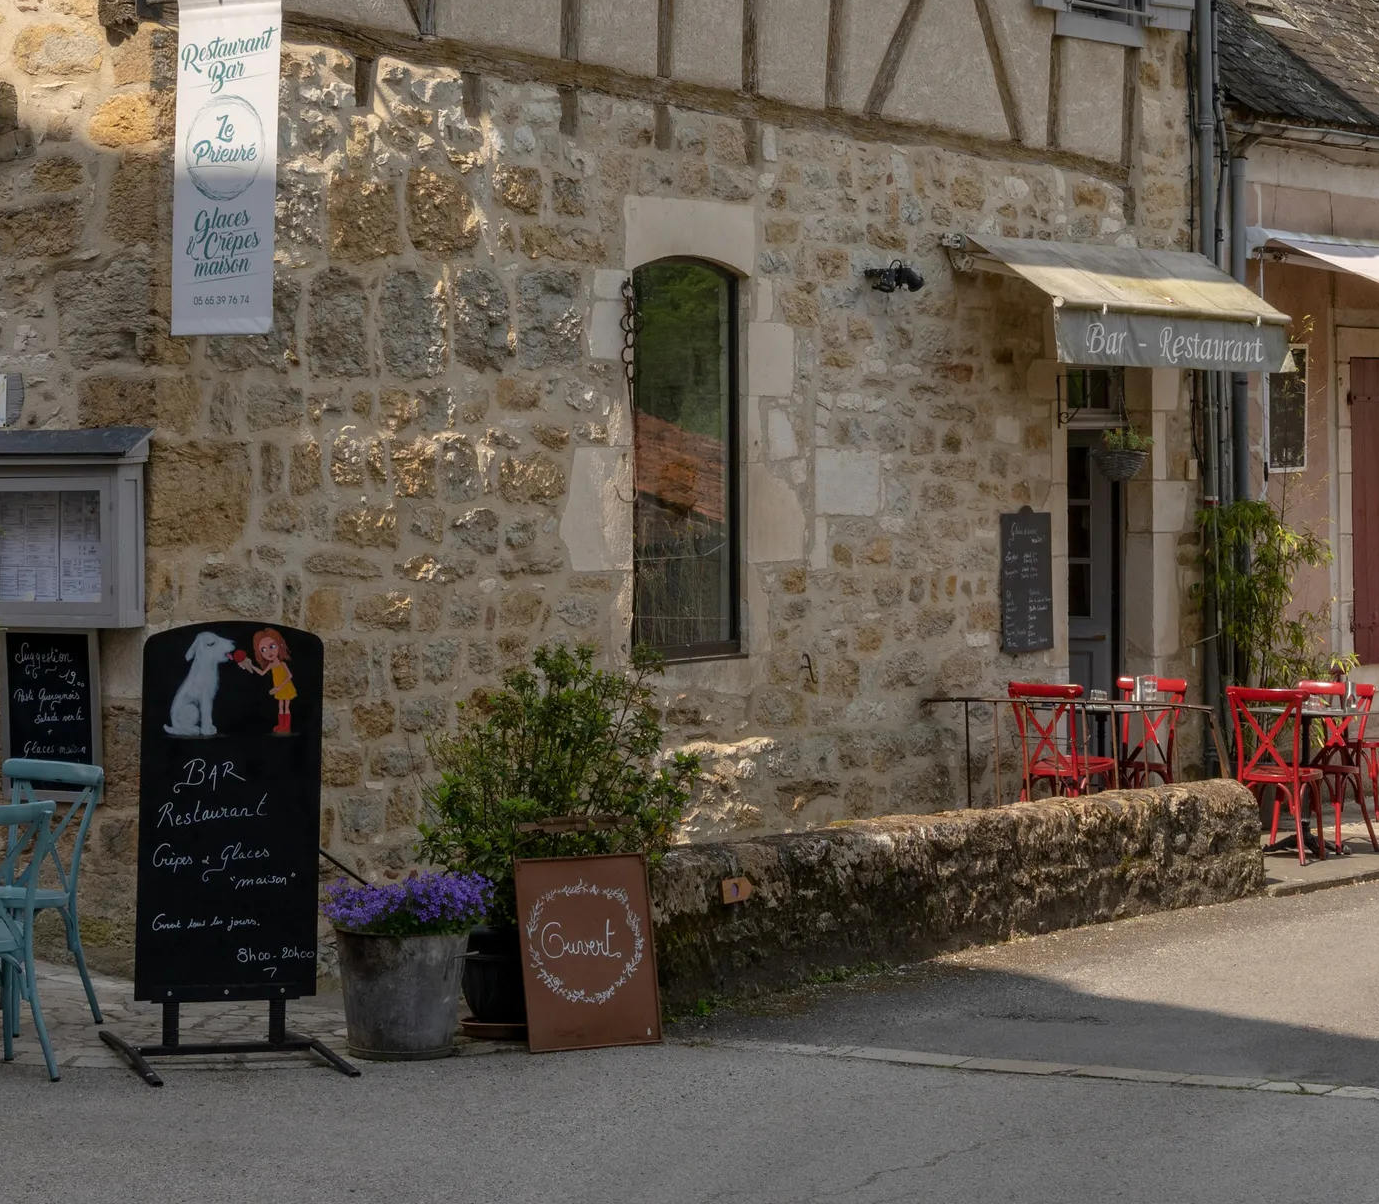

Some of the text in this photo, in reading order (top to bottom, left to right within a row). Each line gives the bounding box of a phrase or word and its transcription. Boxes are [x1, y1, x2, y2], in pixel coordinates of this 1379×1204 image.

[182, 26, 278, 74] Restaurant
[208, 60, 245, 94] Bar
[215, 114, 235, 143] Le
[192, 139, 257, 165] Prieuré
[194, 207, 250, 244] Glaces
[186, 231, 261, 261] & Crêpes
[194, 255, 251, 277] maison
[193, 295, 249, 305] 05 65 39 76 74
[1086, 322, 1127, 355] Bar
[1159, 326, 1265, 364] Restaurant
[15, 642, 73, 679] Suggestion
[34, 711, 60, 724] Salade
[23, 740, 55, 759] Glaces
[173, 757, 246, 794] BAR
[157, 793, 268, 828] Restaurant
[201, 842, 270, 882] Glaces
[187, 918, 206, 929] tous
[210, 915, 223, 927] les
[236, 947, 271, 963] 8h00
[281, 946, 315, 959] 20h00
[541, 918, 622, 959] Ouvert
